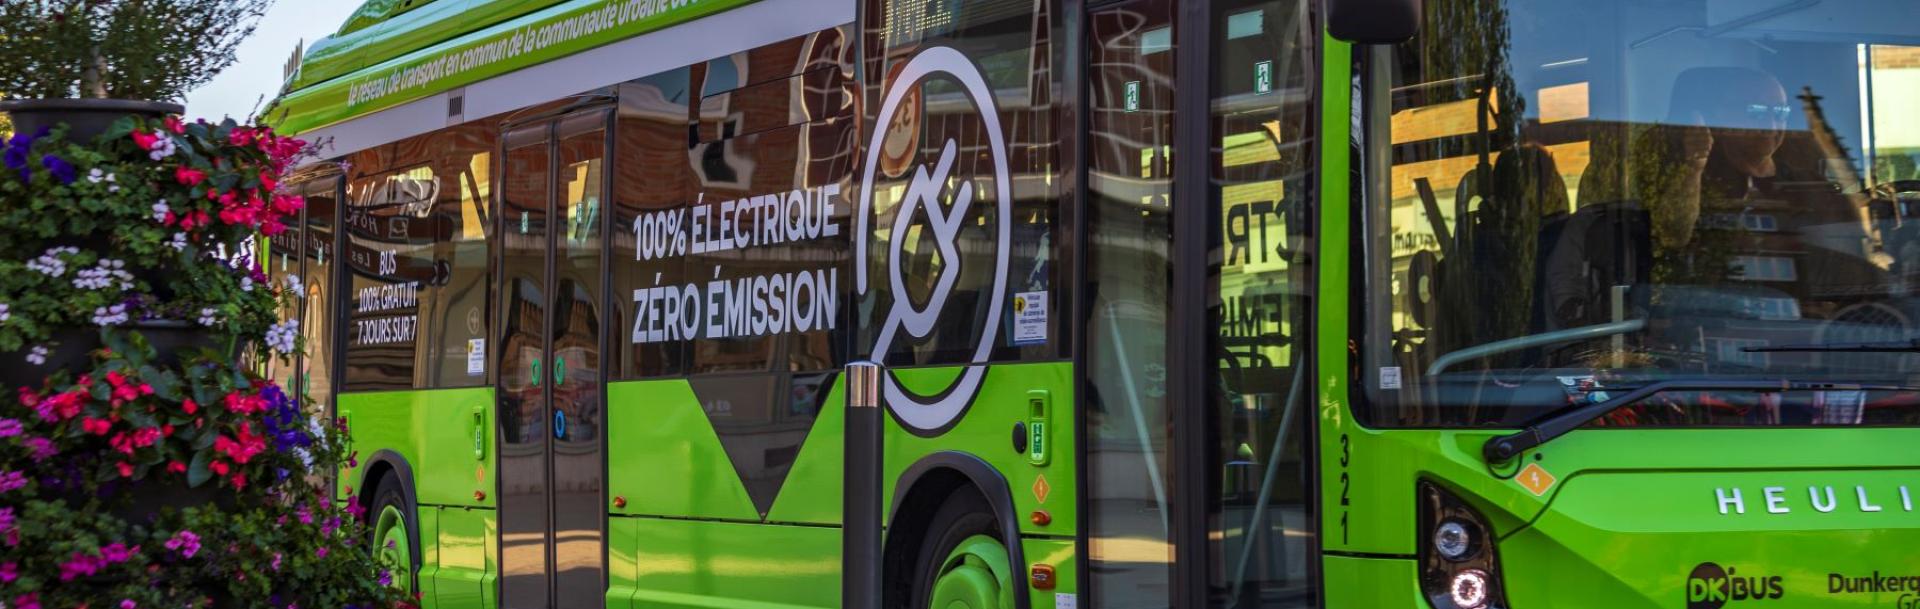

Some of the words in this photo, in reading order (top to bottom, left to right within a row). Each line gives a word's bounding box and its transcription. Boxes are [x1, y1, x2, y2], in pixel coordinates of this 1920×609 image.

[347, 81, 358, 107] le
[357, 75, 388, 103] réseau
[387, 68, 401, 95] de
[400, 55, 448, 89] transport
[446, 52, 461, 77] en
[460, 37, 508, 72] commun
[507, 29, 525, 58] de
[523, 24, 537, 53] la
[535, 1, 617, 50] communauté
[632, 207, 687, 261] 100%
[691, 183, 840, 254] ÉLECTRIQUE
[379, 249, 397, 276] BUS
[358, 286, 380, 313] 100%
[381, 281, 419, 310] GRATUIT
[632, 272, 701, 344] ZÉRO
[706, 265, 838, 339] ÉMISSION
[357, 321, 364, 345] 7
[363, 318, 392, 344] JOURS
[392, 316, 410, 342] SUR
[411, 315, 418, 341] 7
[1340, 433, 1350, 545] 321
[1714, 485, 1914, 515] HEULI
